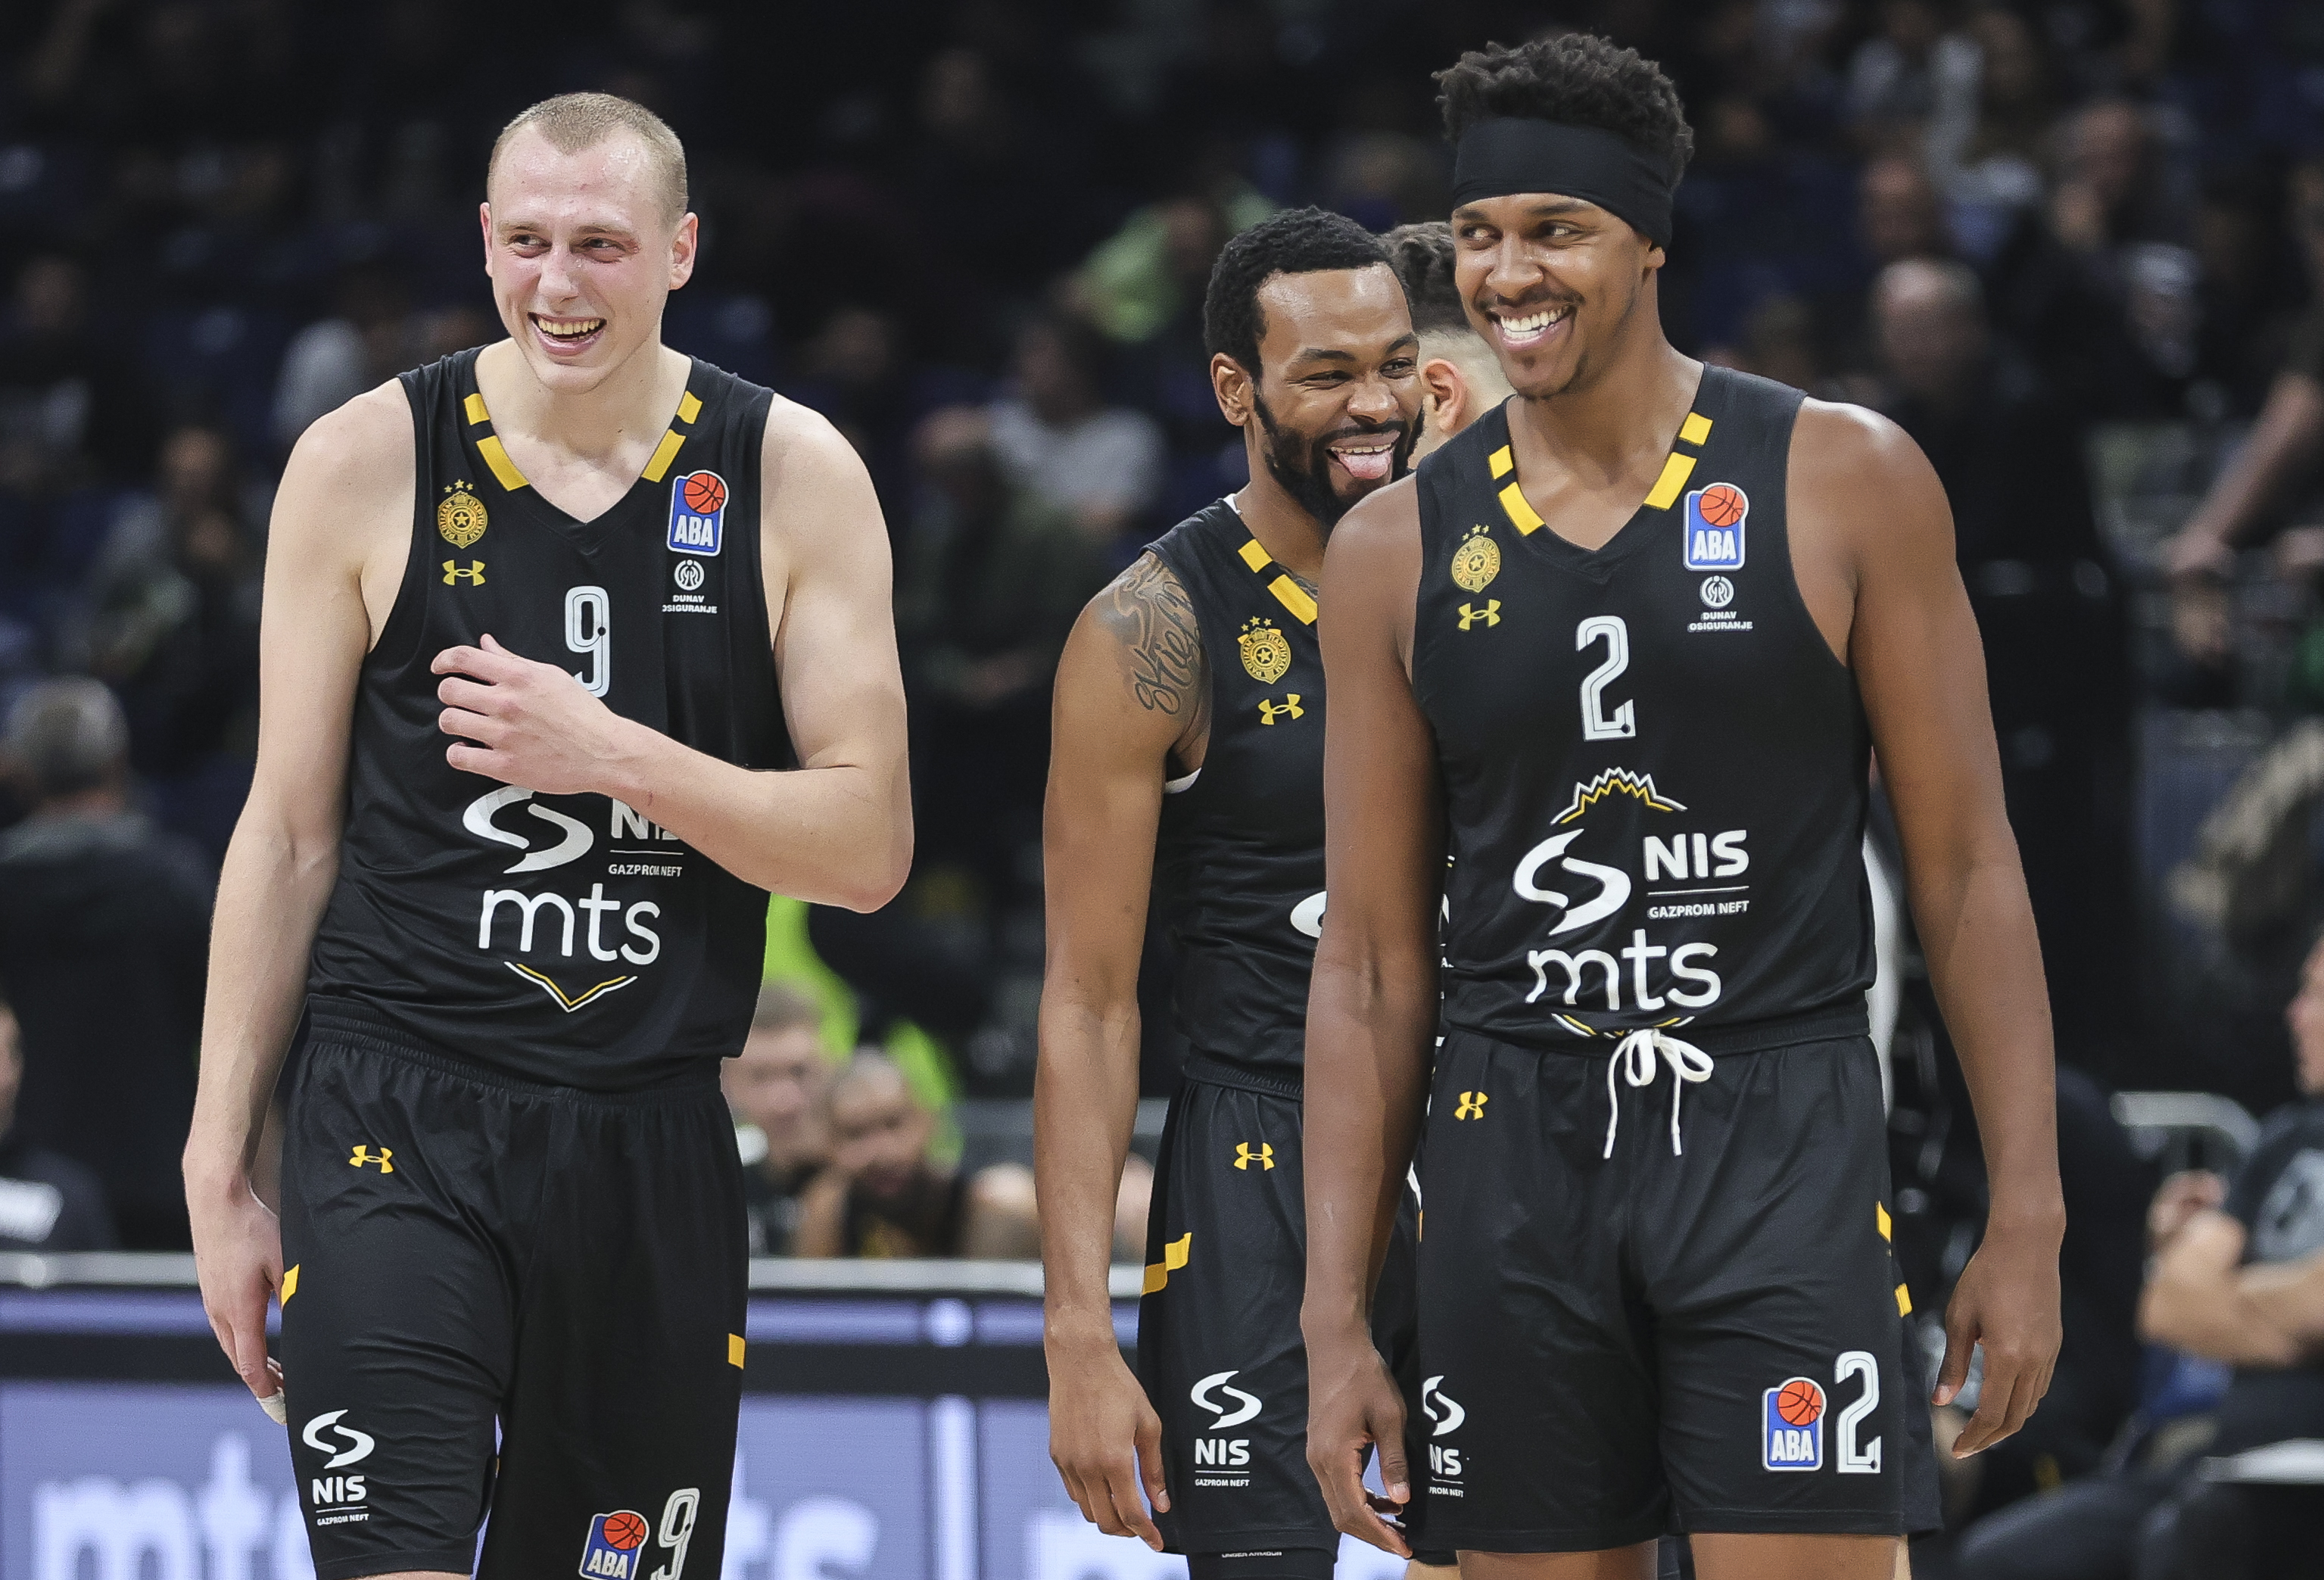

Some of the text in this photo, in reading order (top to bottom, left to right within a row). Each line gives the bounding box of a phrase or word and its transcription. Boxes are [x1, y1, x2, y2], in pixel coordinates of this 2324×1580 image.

[673, 514, 714, 547] ABA
[1693, 530, 1737, 561] ABA
[672, 594, 705, 603] DUNAV
[1687, 621, 1754, 631] OSIGURANJE
[1701, 611, 1737, 620] DUNAV
[565, 585, 610, 698] 9
[1575, 615, 1637, 742] 2
[1643, 829, 1749, 882] NIS
[478, 883, 661, 965] mts
[1648, 900, 1750, 919] GAZPROM NEFT
[1525, 928, 1722, 1011] mts
[1833, 1351, 1882, 1474] 2
[1195, 1438, 1250, 1466] NIS
[1771, 1429, 1815, 1462] ABA
[312, 1475, 367, 1505] NIS
[1195, 1479, 1251, 1487] GAZPROM NEFT
[316, 1513, 369, 1526] GAZPROM NEFT
[650, 1487, 700, 1580] 9
[586, 1547, 629, 1579] ABA
